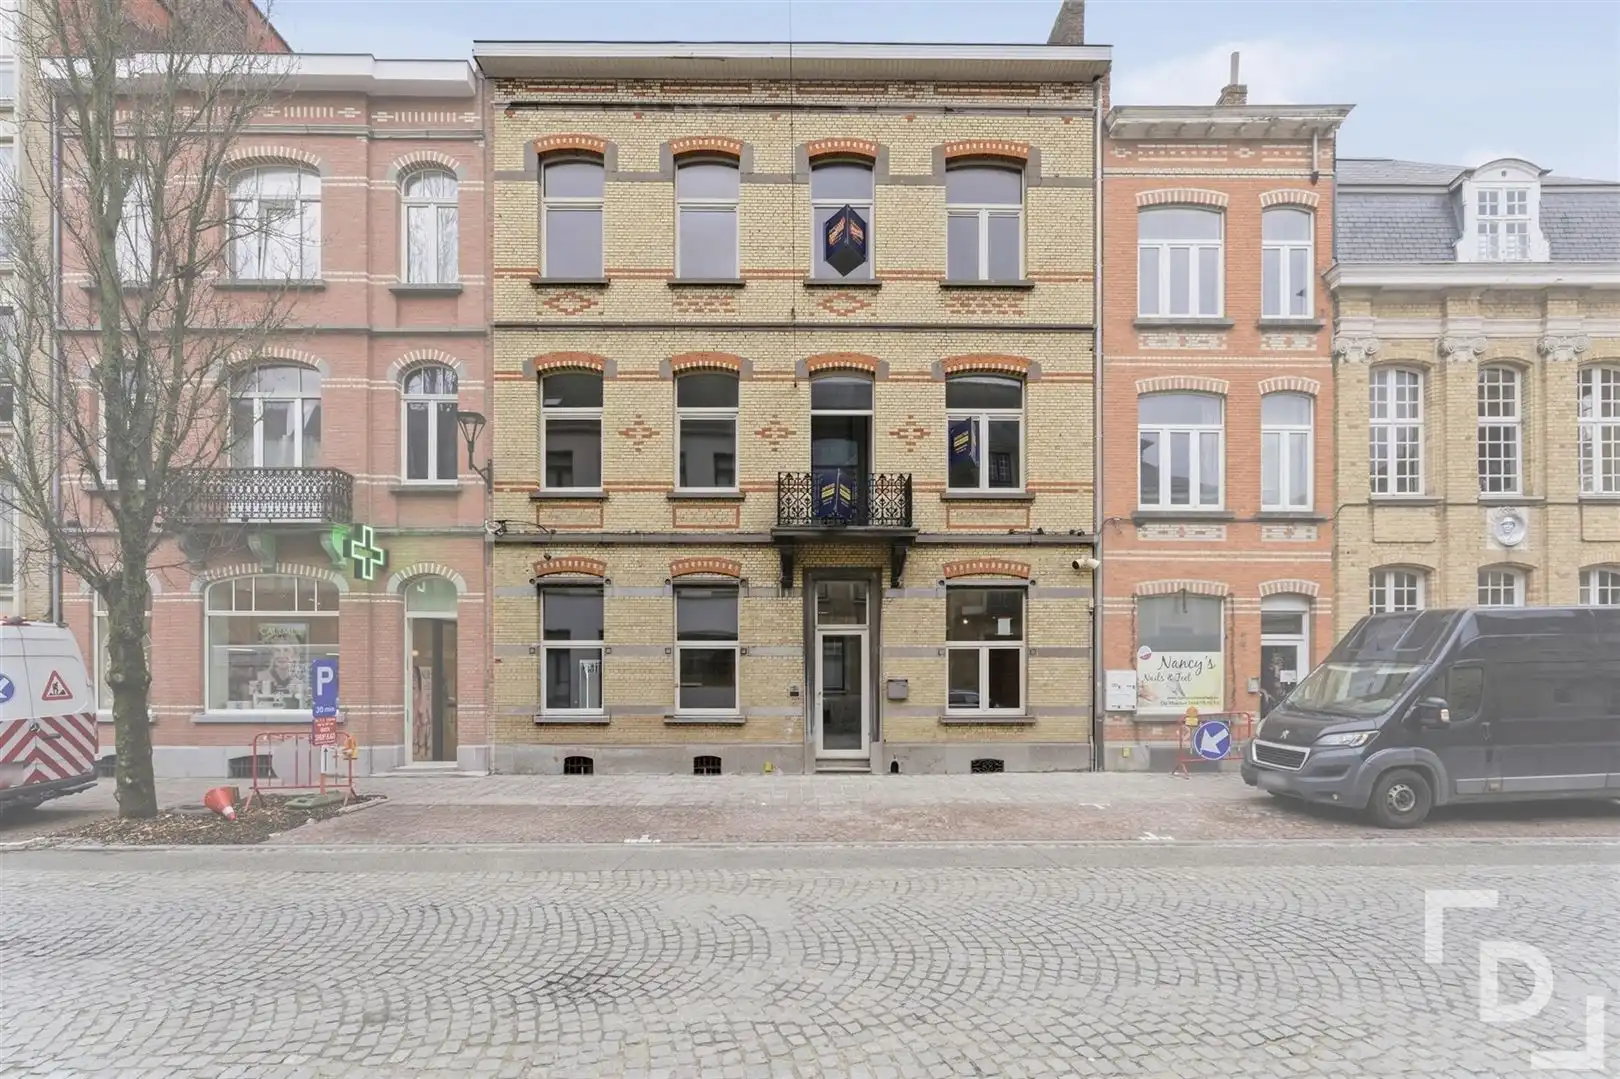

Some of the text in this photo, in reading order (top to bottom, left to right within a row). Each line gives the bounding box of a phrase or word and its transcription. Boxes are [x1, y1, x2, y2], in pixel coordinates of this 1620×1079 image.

[1157, 655, 1217, 676] Nancy's
[317, 666, 334, 696] P
[1144, 672, 1165, 682] Nails
